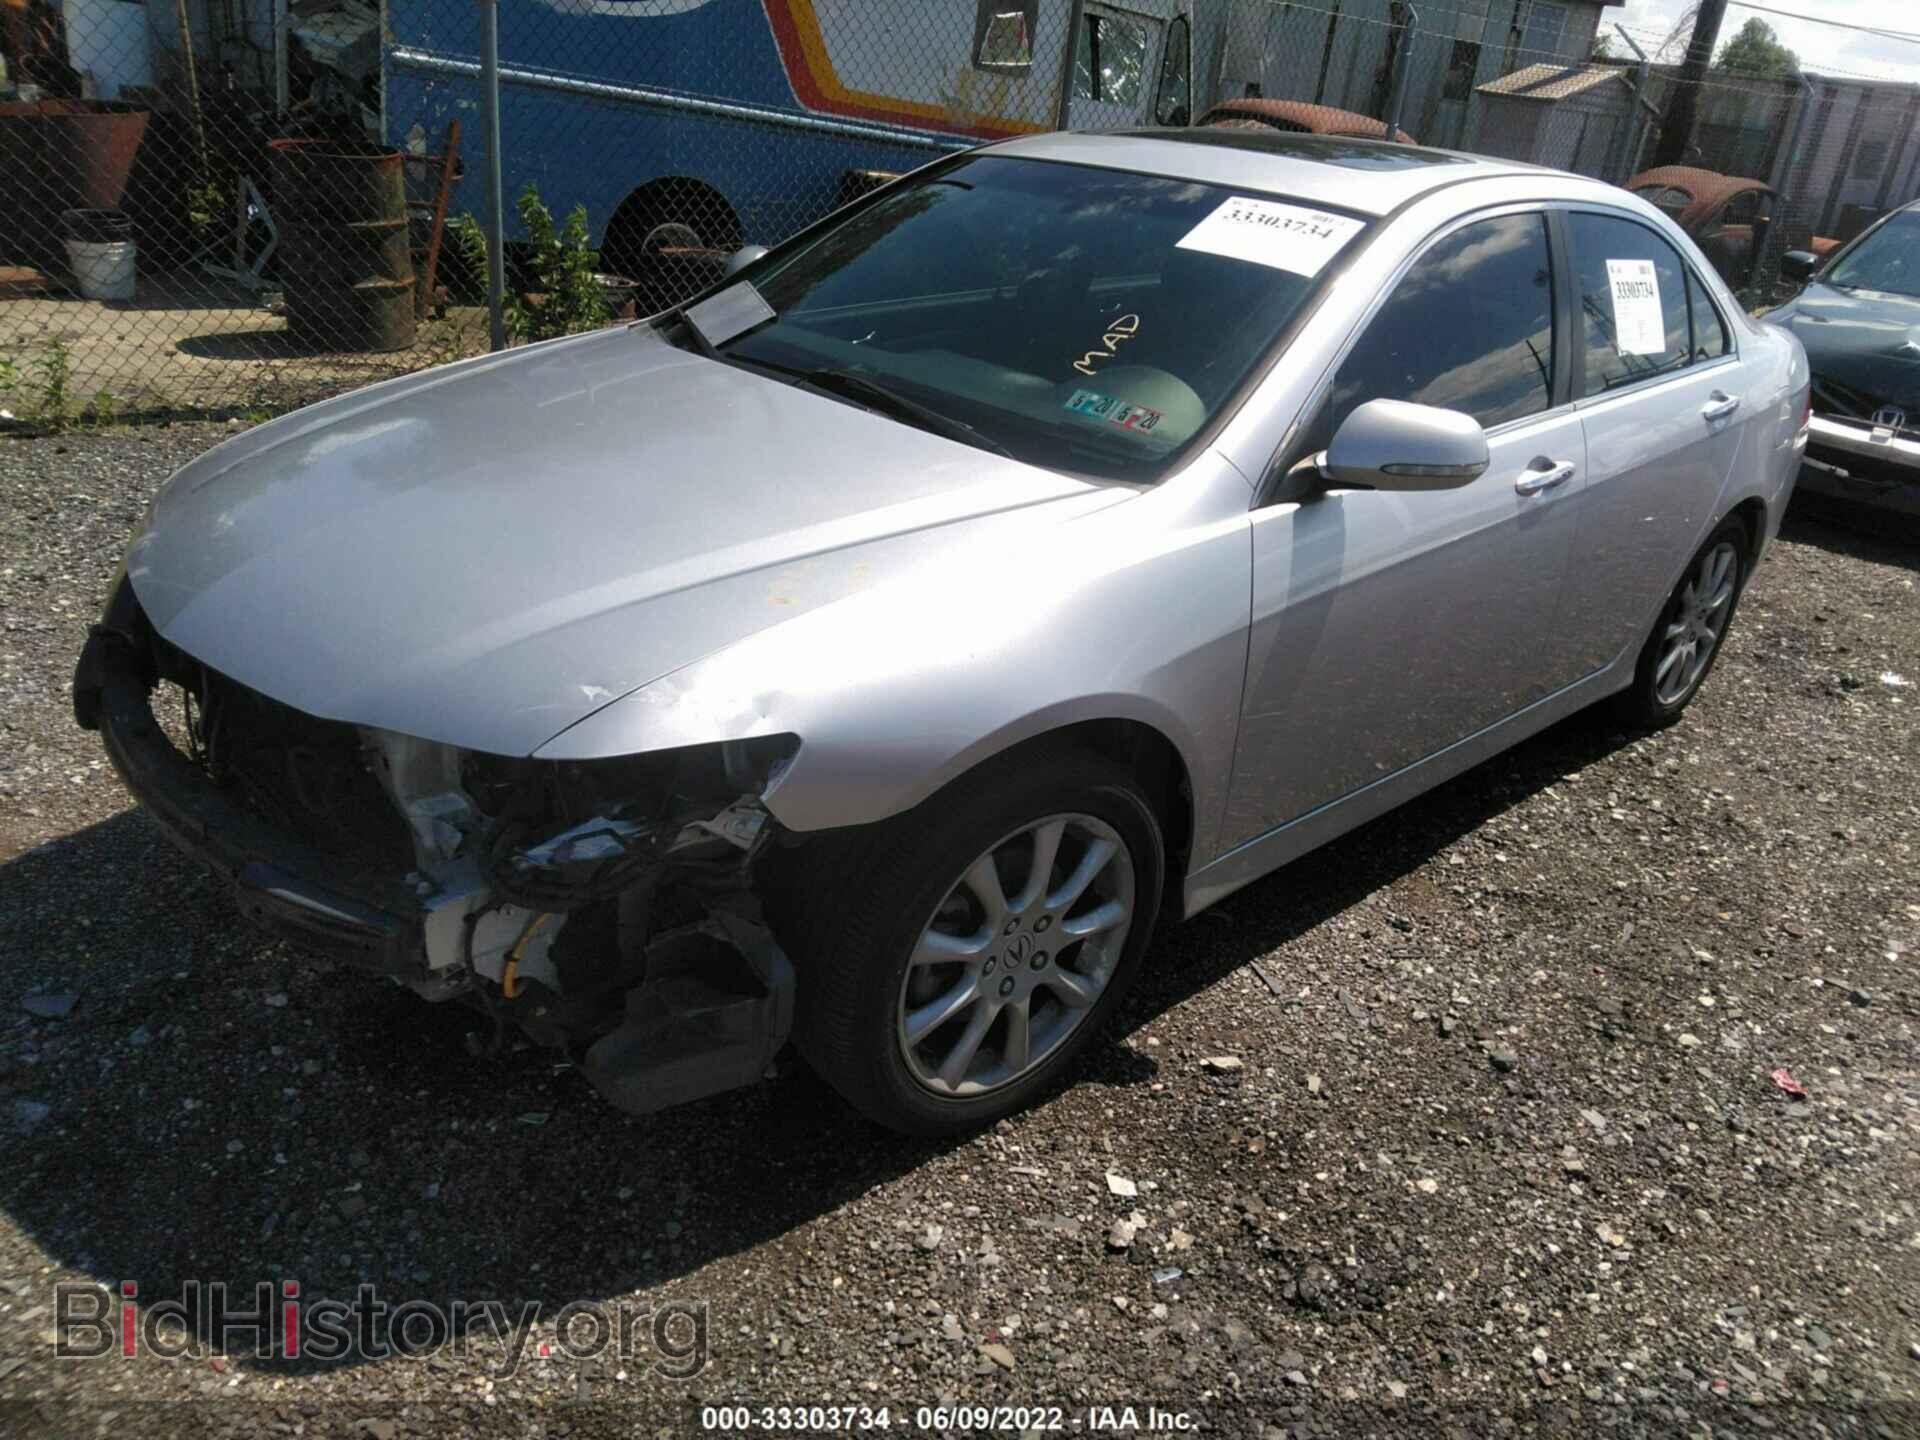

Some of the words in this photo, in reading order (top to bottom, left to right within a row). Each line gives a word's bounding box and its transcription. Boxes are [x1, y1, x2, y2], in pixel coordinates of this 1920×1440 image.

[1224, 209, 1333, 239] 33303734
[1616, 281, 1654, 299] 33303734
[1073, 314, 1139, 375] MAD
[1140, 411, 1160, 429] 20
